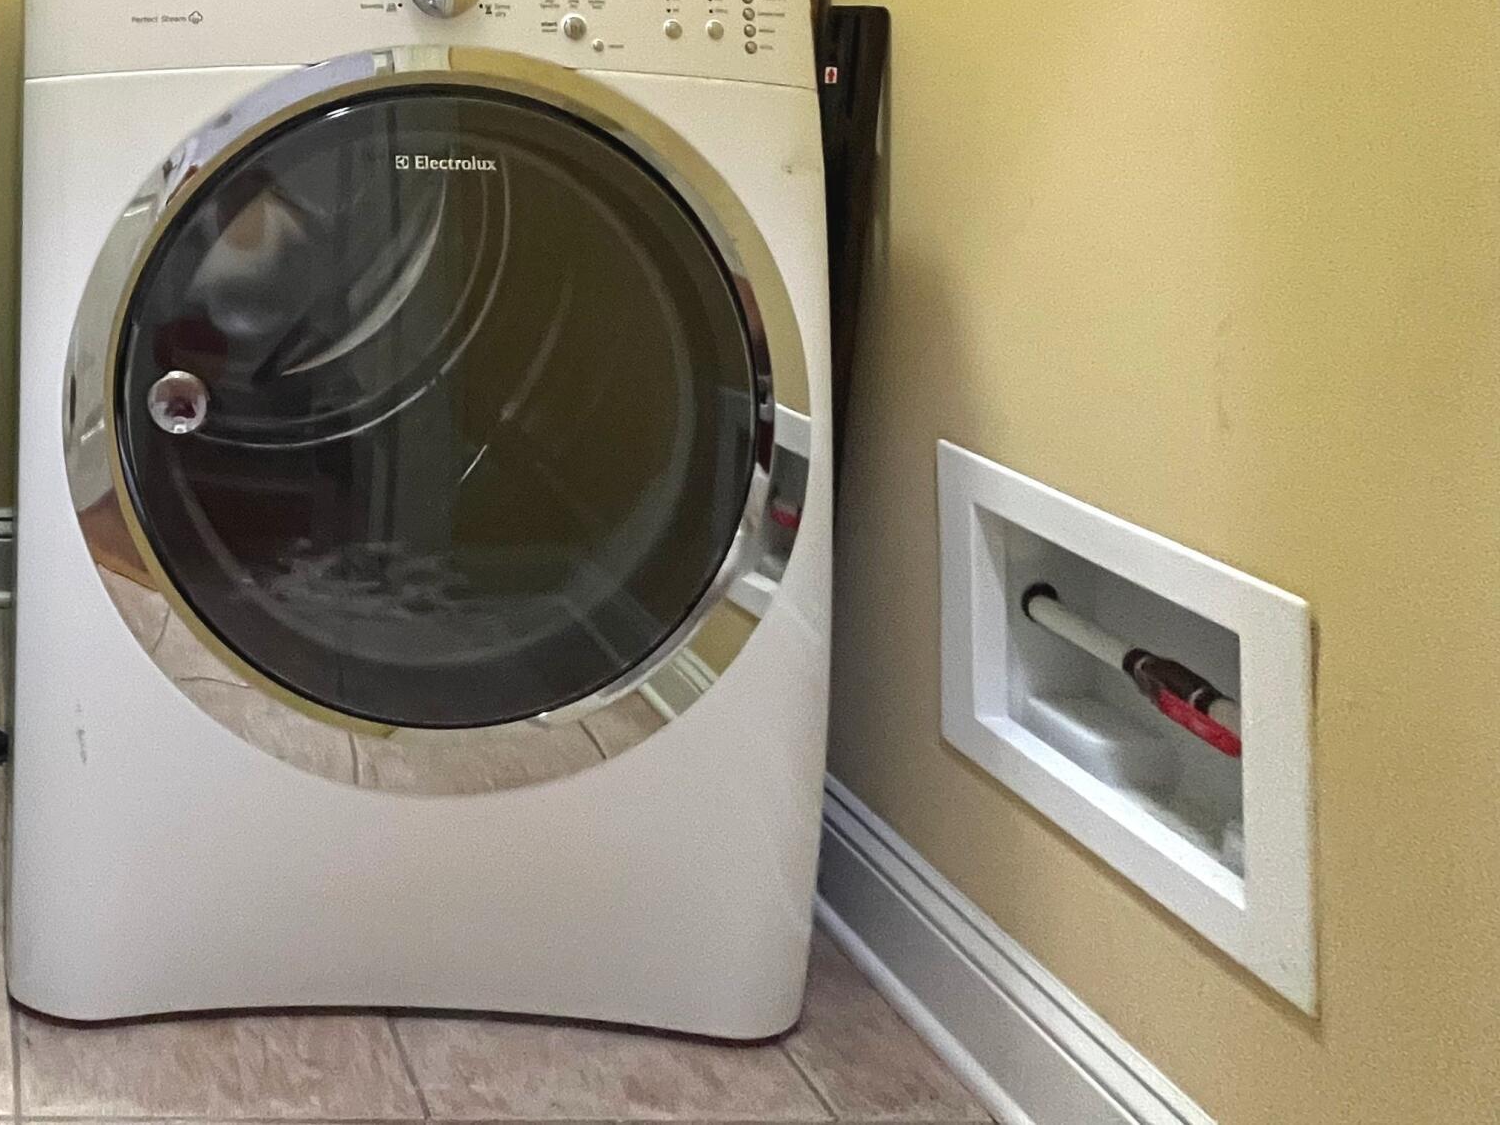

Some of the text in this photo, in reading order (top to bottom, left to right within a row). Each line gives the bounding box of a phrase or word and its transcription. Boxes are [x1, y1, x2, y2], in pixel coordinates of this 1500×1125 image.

[131, 14, 188, 24] Perfect Steam
[414, 155, 498, 171] Electrolux
